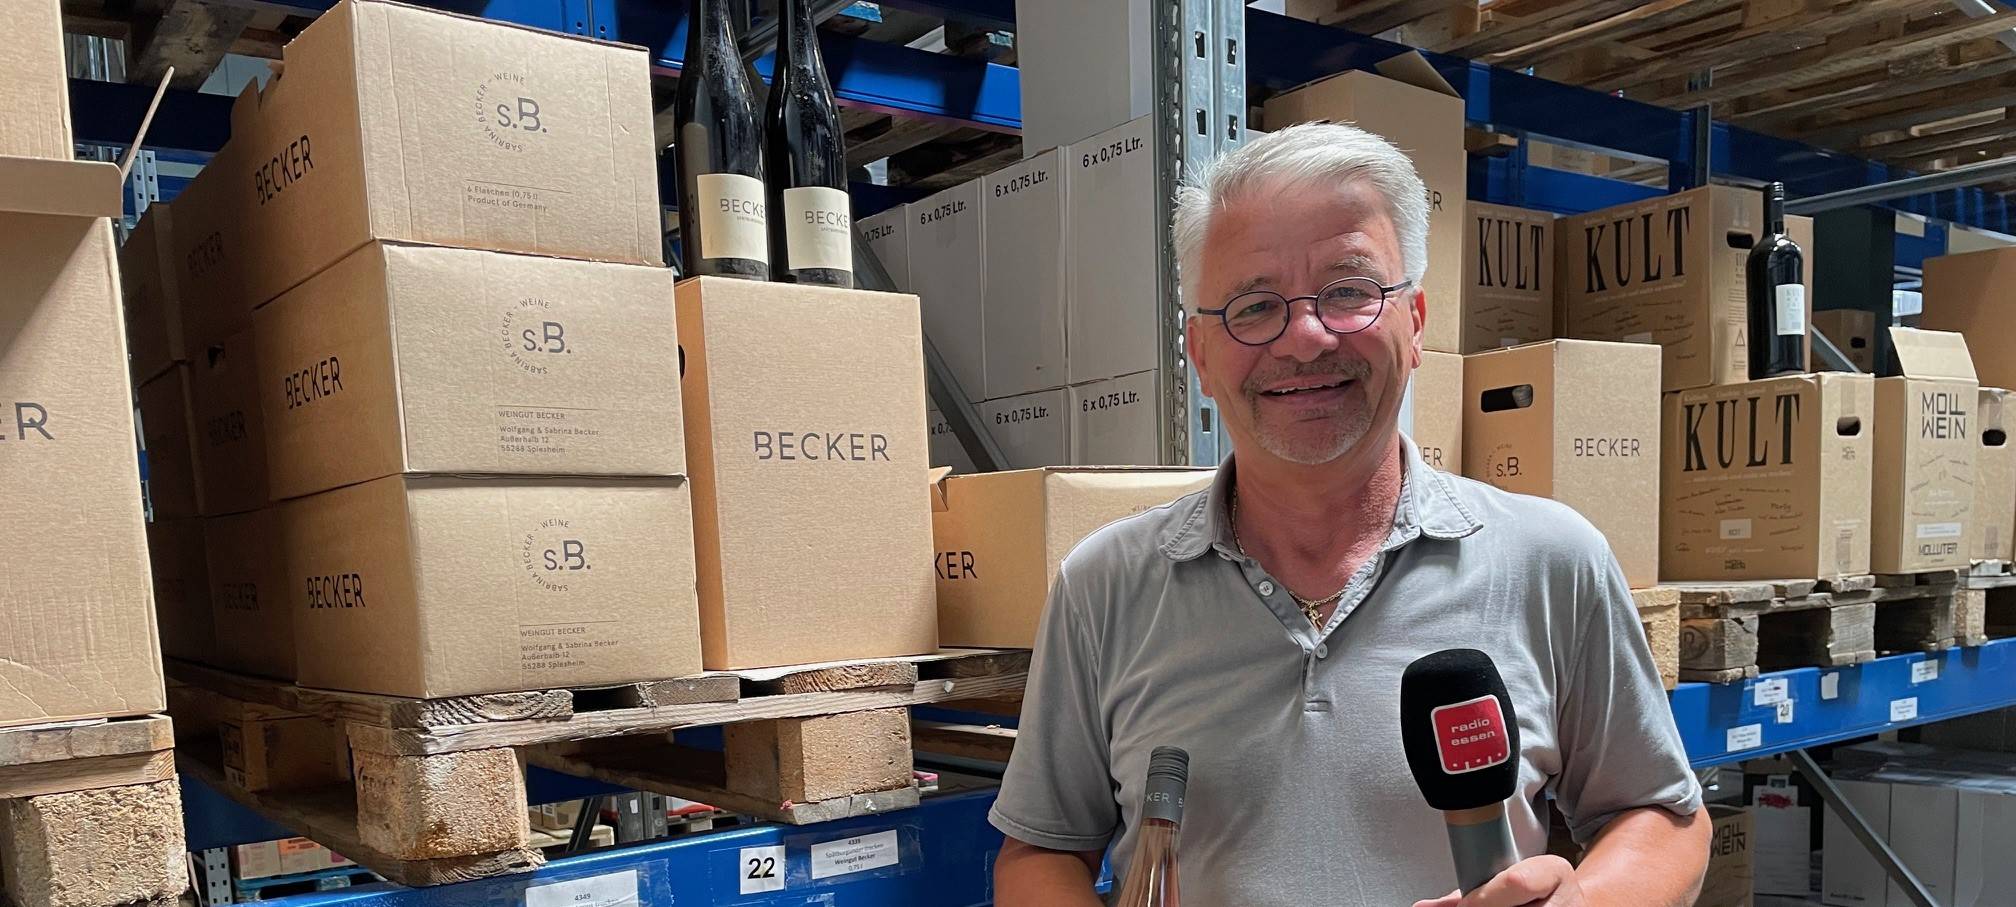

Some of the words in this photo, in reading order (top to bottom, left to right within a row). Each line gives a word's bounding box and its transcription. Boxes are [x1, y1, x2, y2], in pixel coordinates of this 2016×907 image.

[494, 72, 525, 86] WEINE
[475, 83, 488, 123] BECKER
[496, 97, 547, 133] s.B.
[484, 125, 523, 153] SABRINA
[1082, 153, 1089, 168] 6
[1092, 152, 1098, 164] x
[1100, 141, 1123, 163] 0,75
[1125, 136, 1143, 154] Ltr.
[255, 134, 314, 206] BECKER
[995, 184, 1001, 198] 6
[1003, 185, 1009, 195] x
[1011, 173, 1030, 193] 0,75
[1032, 168, 1048, 185] Ltr.
[467, 195, 499, 206] Product
[513, 201, 547, 212] Germany
[920, 212, 926, 225] 6
[927, 213, 933, 224] x
[934, 203, 951, 221] 0,75
[953, 199, 967, 214] Ltr.
[881, 224, 895, 237] Ltr.
[1477, 217, 1544, 291] KULT
[1584, 206, 1690, 293] KULT
[520, 298, 550, 309] WEINE
[501, 311, 513, 349] BECKER
[522, 321, 571, 354] s.B.
[510, 351, 548, 375] SABRINA
[285, 356, 343, 410] BECKER
[1082, 400, 1088, 412] 6
[1090, 400, 1097, 411] x
[1098, 393, 1120, 411] 0,75
[1122, 390, 1140, 406] Ltr.
[1922, 392, 1966, 416] MOLL
[0, 402, 55, 440] R
[498, 410, 534, 419] WEINGUT
[536, 411, 565, 420] BECKER
[996, 413, 1002, 425] 6
[1003, 413, 1010, 424] x
[1012, 407, 1031, 424] 0,75
[1033, 405, 1049, 419] Ltr.
[499, 425, 535, 435] Wolfgang
[544, 426, 572, 435] Sabrina
[574, 427, 599, 436] Becker
[1683, 393, 1800, 472] KULT
[1922, 416, 1966, 439] WEIN
[754, 431, 890, 461] BECKER
[1418, 447, 1443, 466] ER
[1574, 438, 1641, 457] BECKER
[540, 518, 570, 529] WEINE
[523, 533, 534, 570] BECKER
[543, 539, 592, 571] s.B.
[306, 573, 366, 609] BECKER
[532, 572, 569, 592] SABRINA
[520, 628, 555, 637] WEINGUT
[558, 627, 586, 635] BECKER
[521, 643, 556, 652] Wolfgang
[558, 642, 563, 650] &
[566, 640, 592, 649] Sabrina
[594, 639, 619, 647] Becker
[1451, 718, 1490, 733] radio
[1451, 730, 1496, 746] essen
[1144, 792, 1170, 804] KER
[748, 856, 776, 879] 22
[834, 856, 857, 865] Weingut
[858, 853, 876, 862] Becker
[574, 893, 591, 901] 4349
